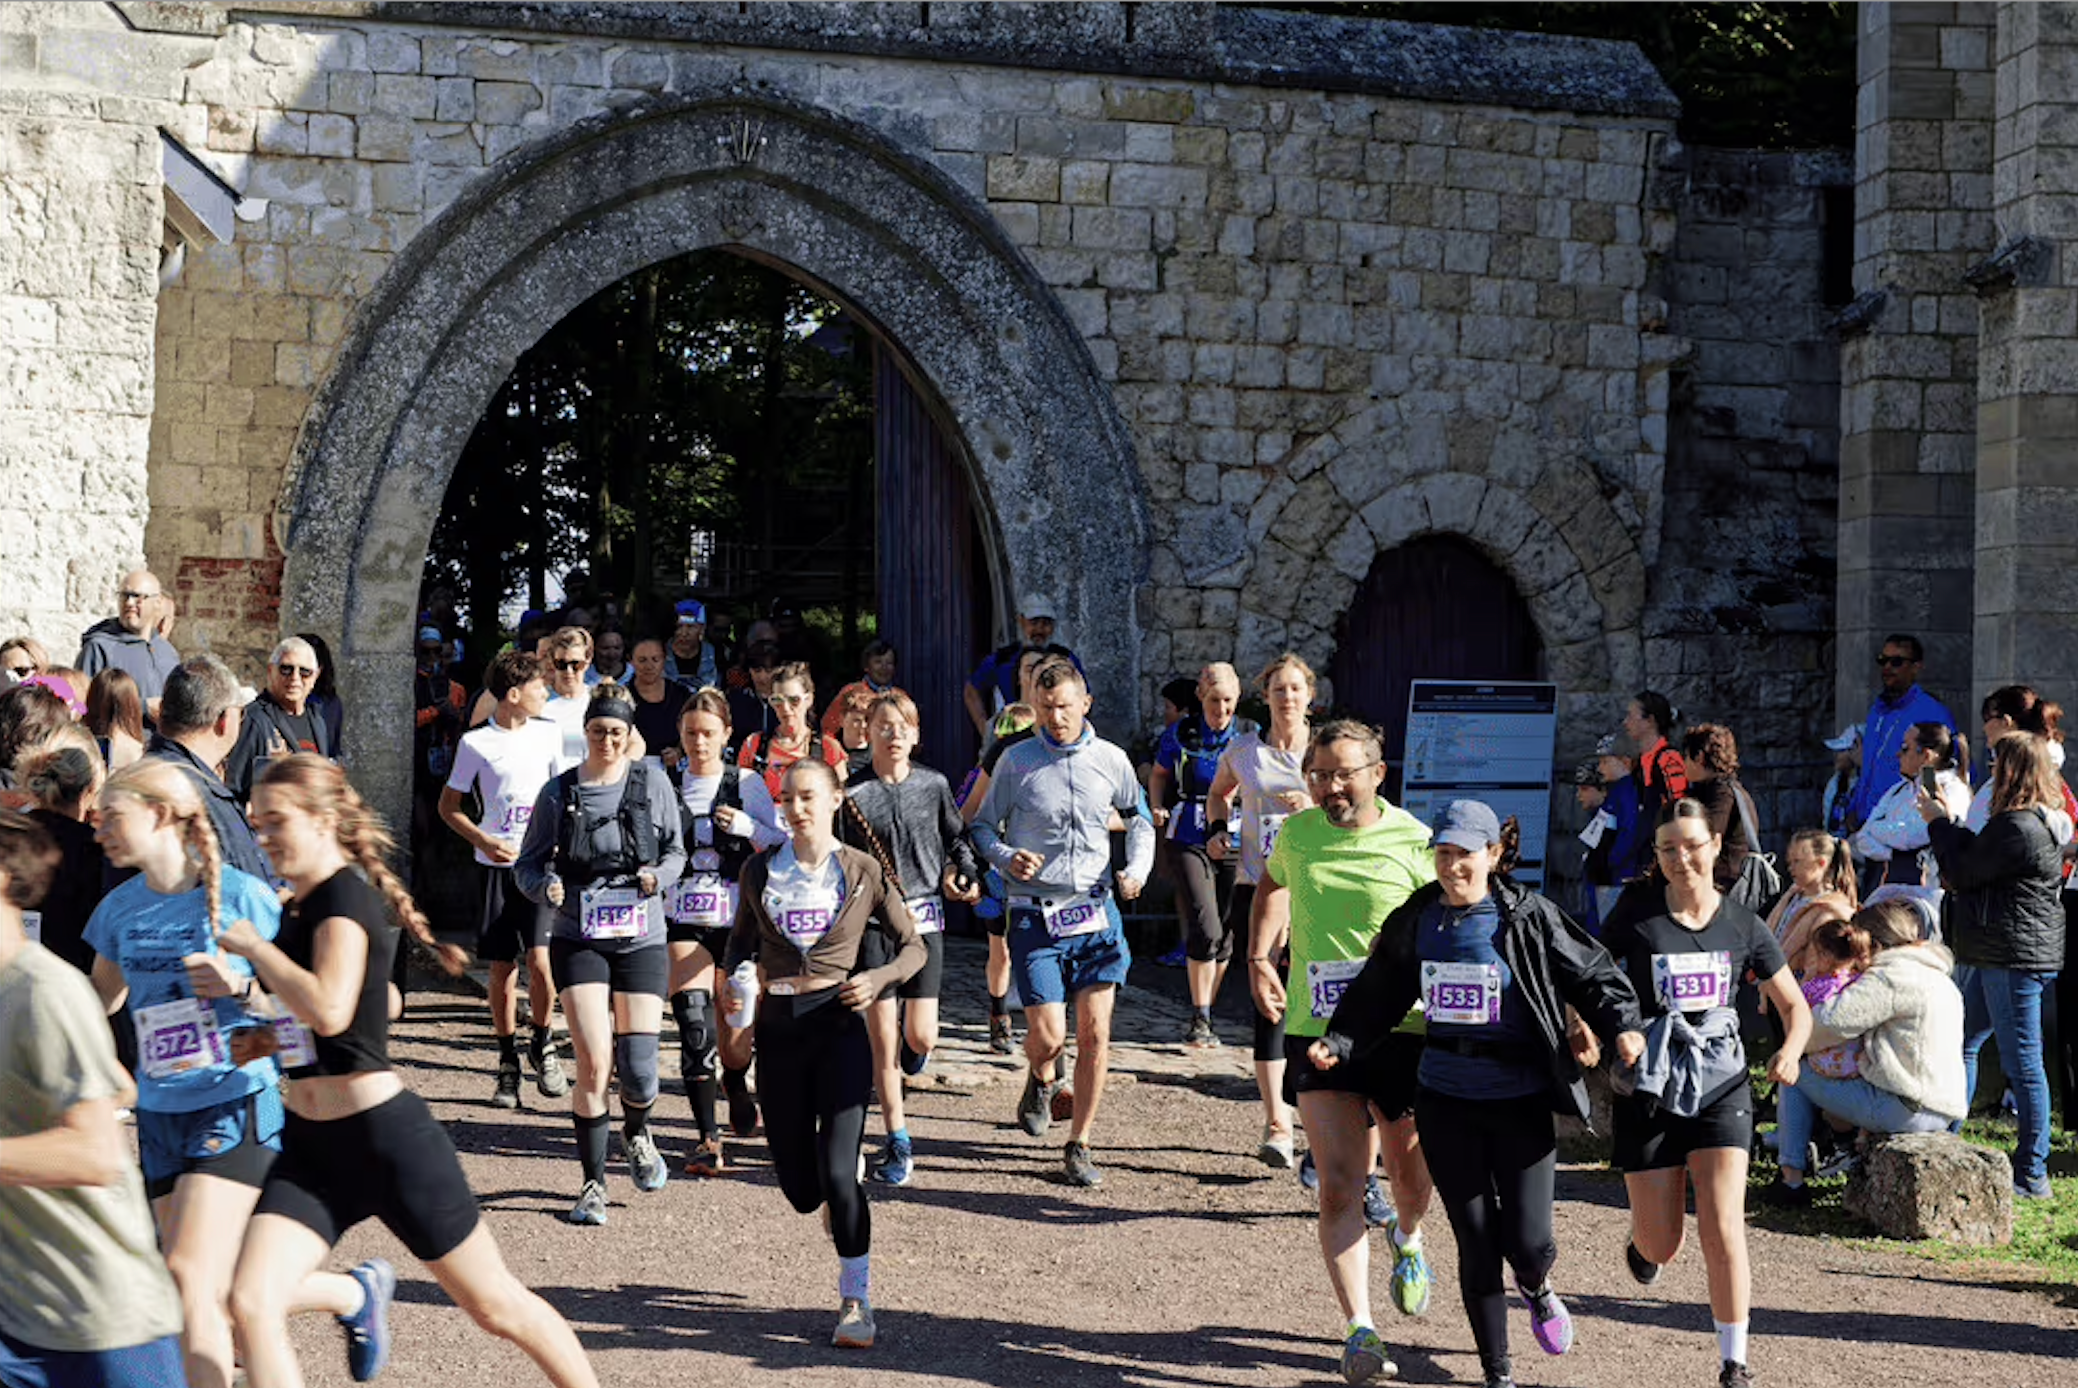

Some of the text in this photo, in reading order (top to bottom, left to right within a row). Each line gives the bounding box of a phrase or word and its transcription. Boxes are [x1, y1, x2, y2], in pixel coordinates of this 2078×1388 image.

[685, 895, 715, 911] 527
[600, 907, 631, 925] 519
[790, 911, 827, 931] 555
[1675, 975, 1710, 996] 531
[1441, 986, 1480, 1007] 533
[157, 1028, 198, 1057] 572
